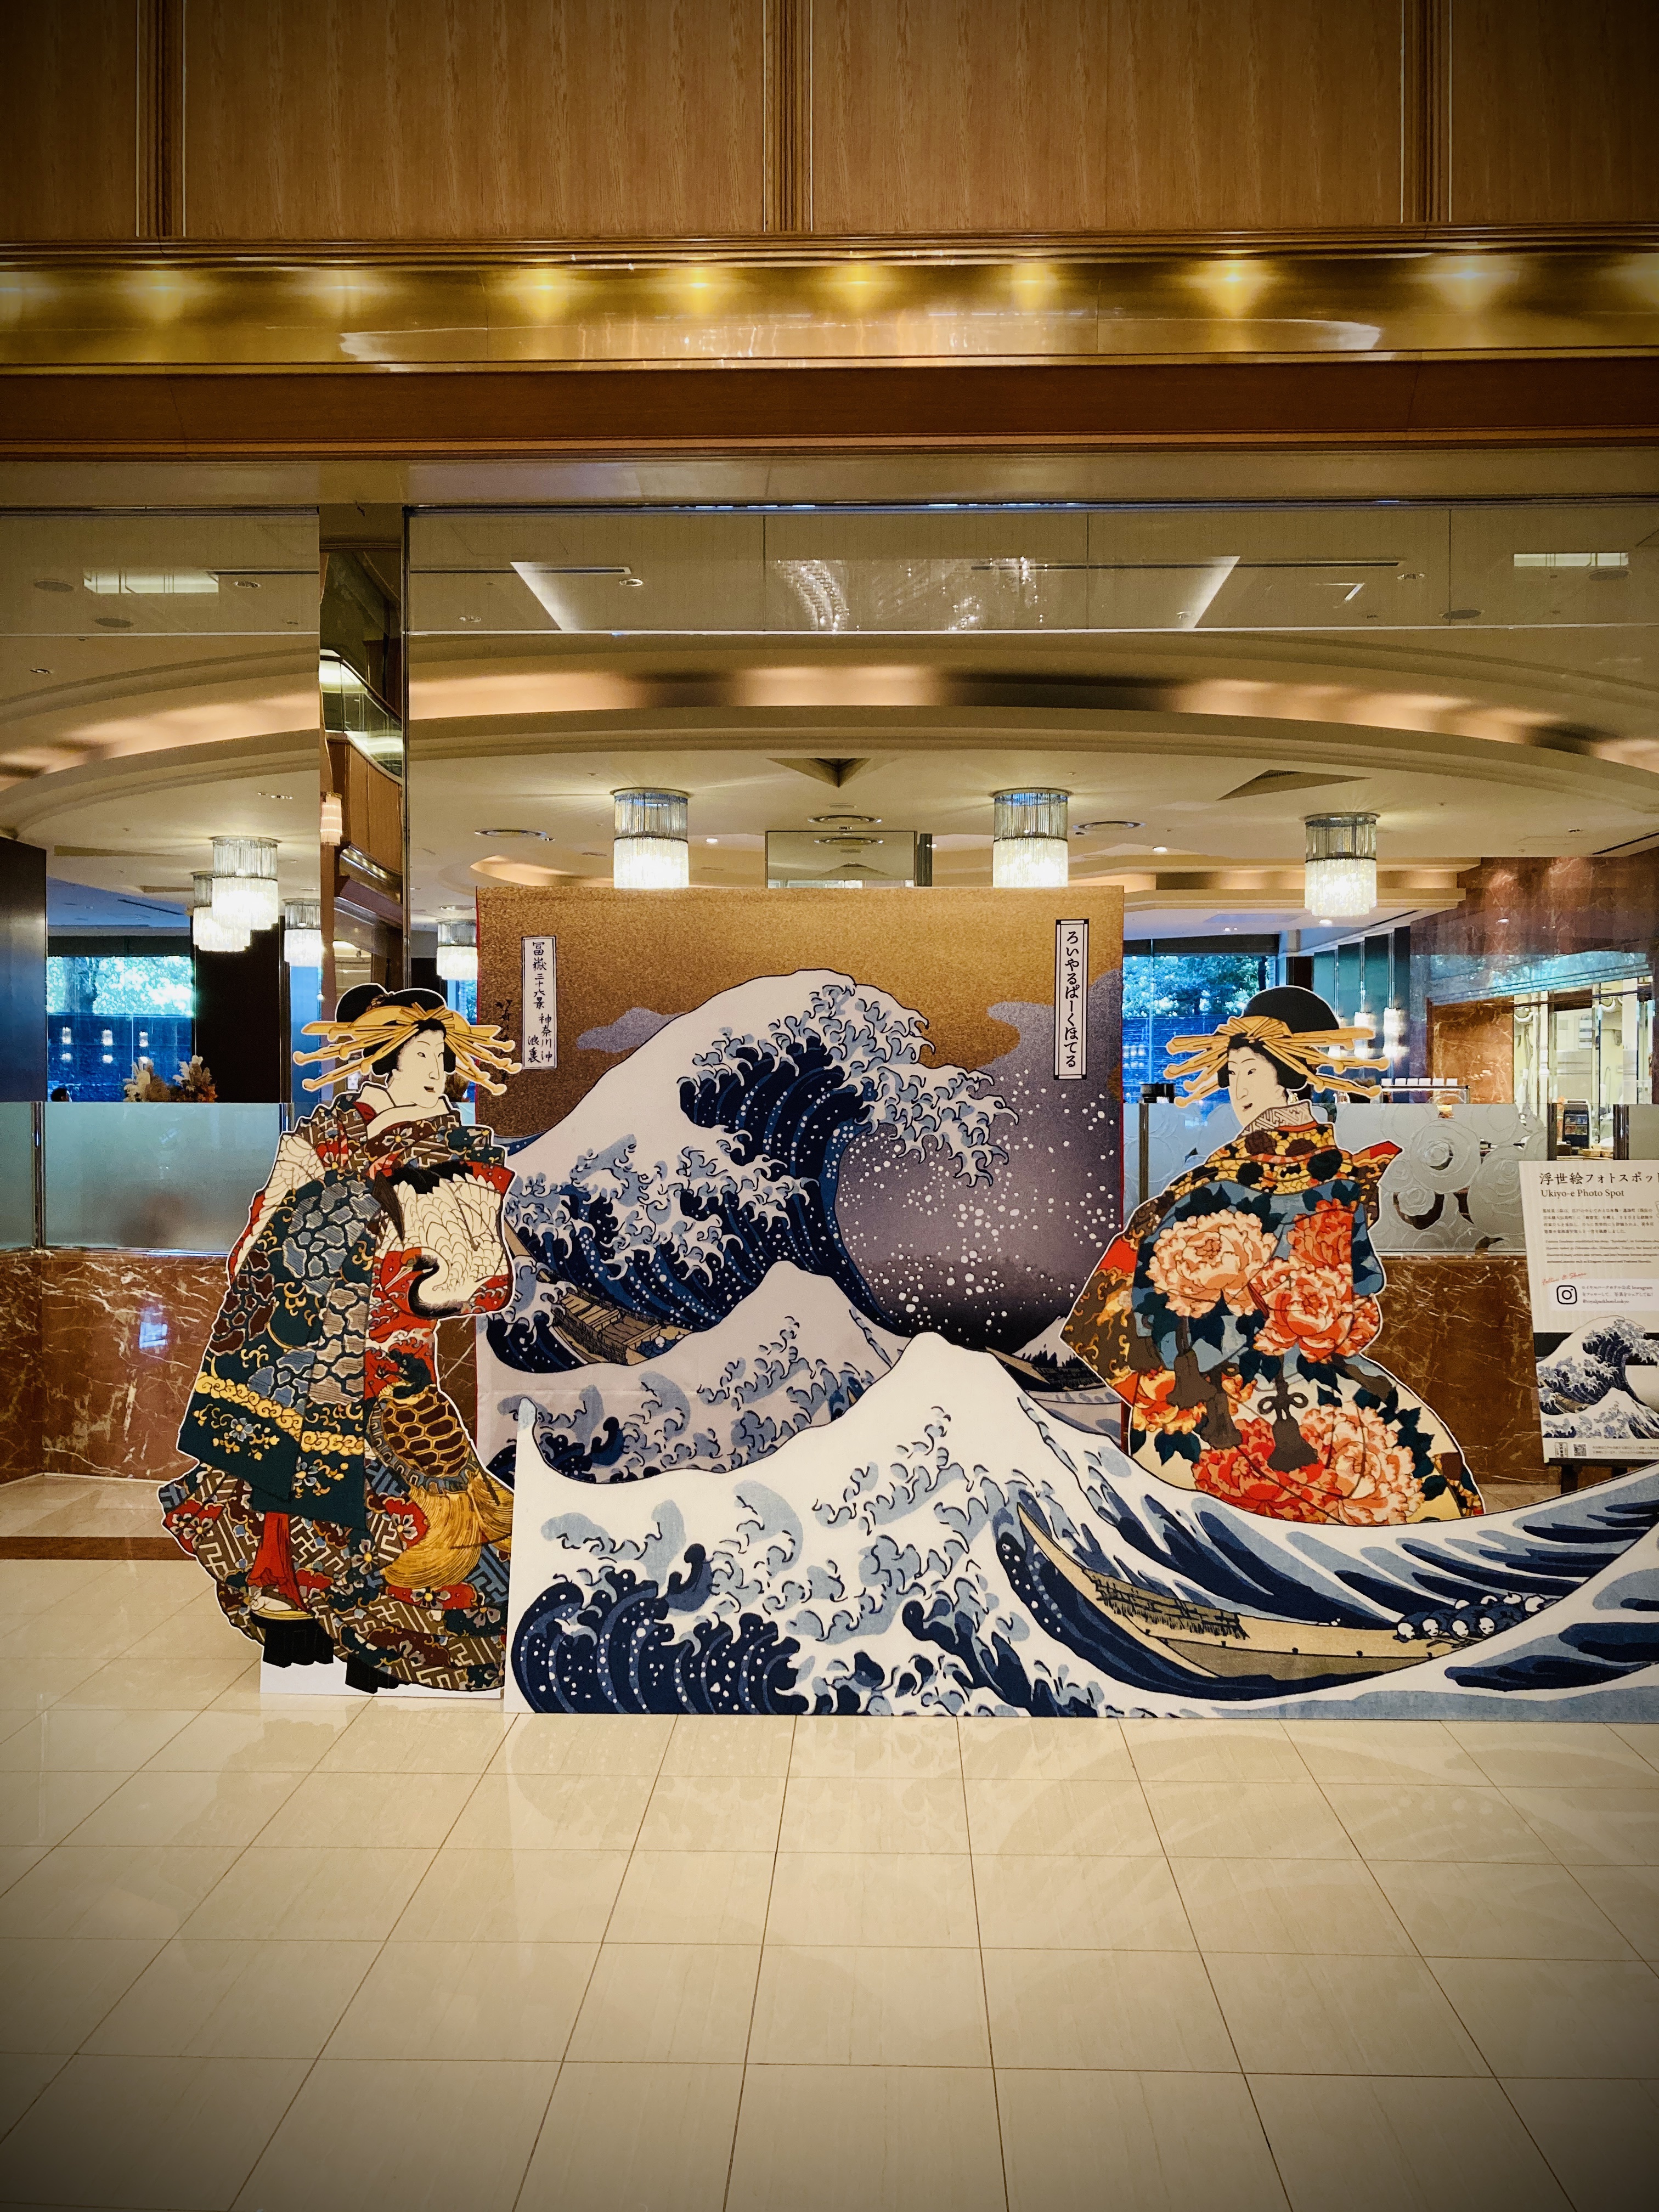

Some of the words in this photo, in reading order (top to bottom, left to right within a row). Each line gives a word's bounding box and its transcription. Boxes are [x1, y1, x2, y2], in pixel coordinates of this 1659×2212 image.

[1063, 930, 1080, 1068] ろいやるぱーくほてる
[527, 1035, 541, 1063] 浪裏
[538, 1013, 553, 1063] 神奈川沖
[1541, 1189, 1575, 1199] Ukiyo-e
[1577, 1189, 1603, 1197] Photo
[1605, 1189, 1624, 1199] Spot
